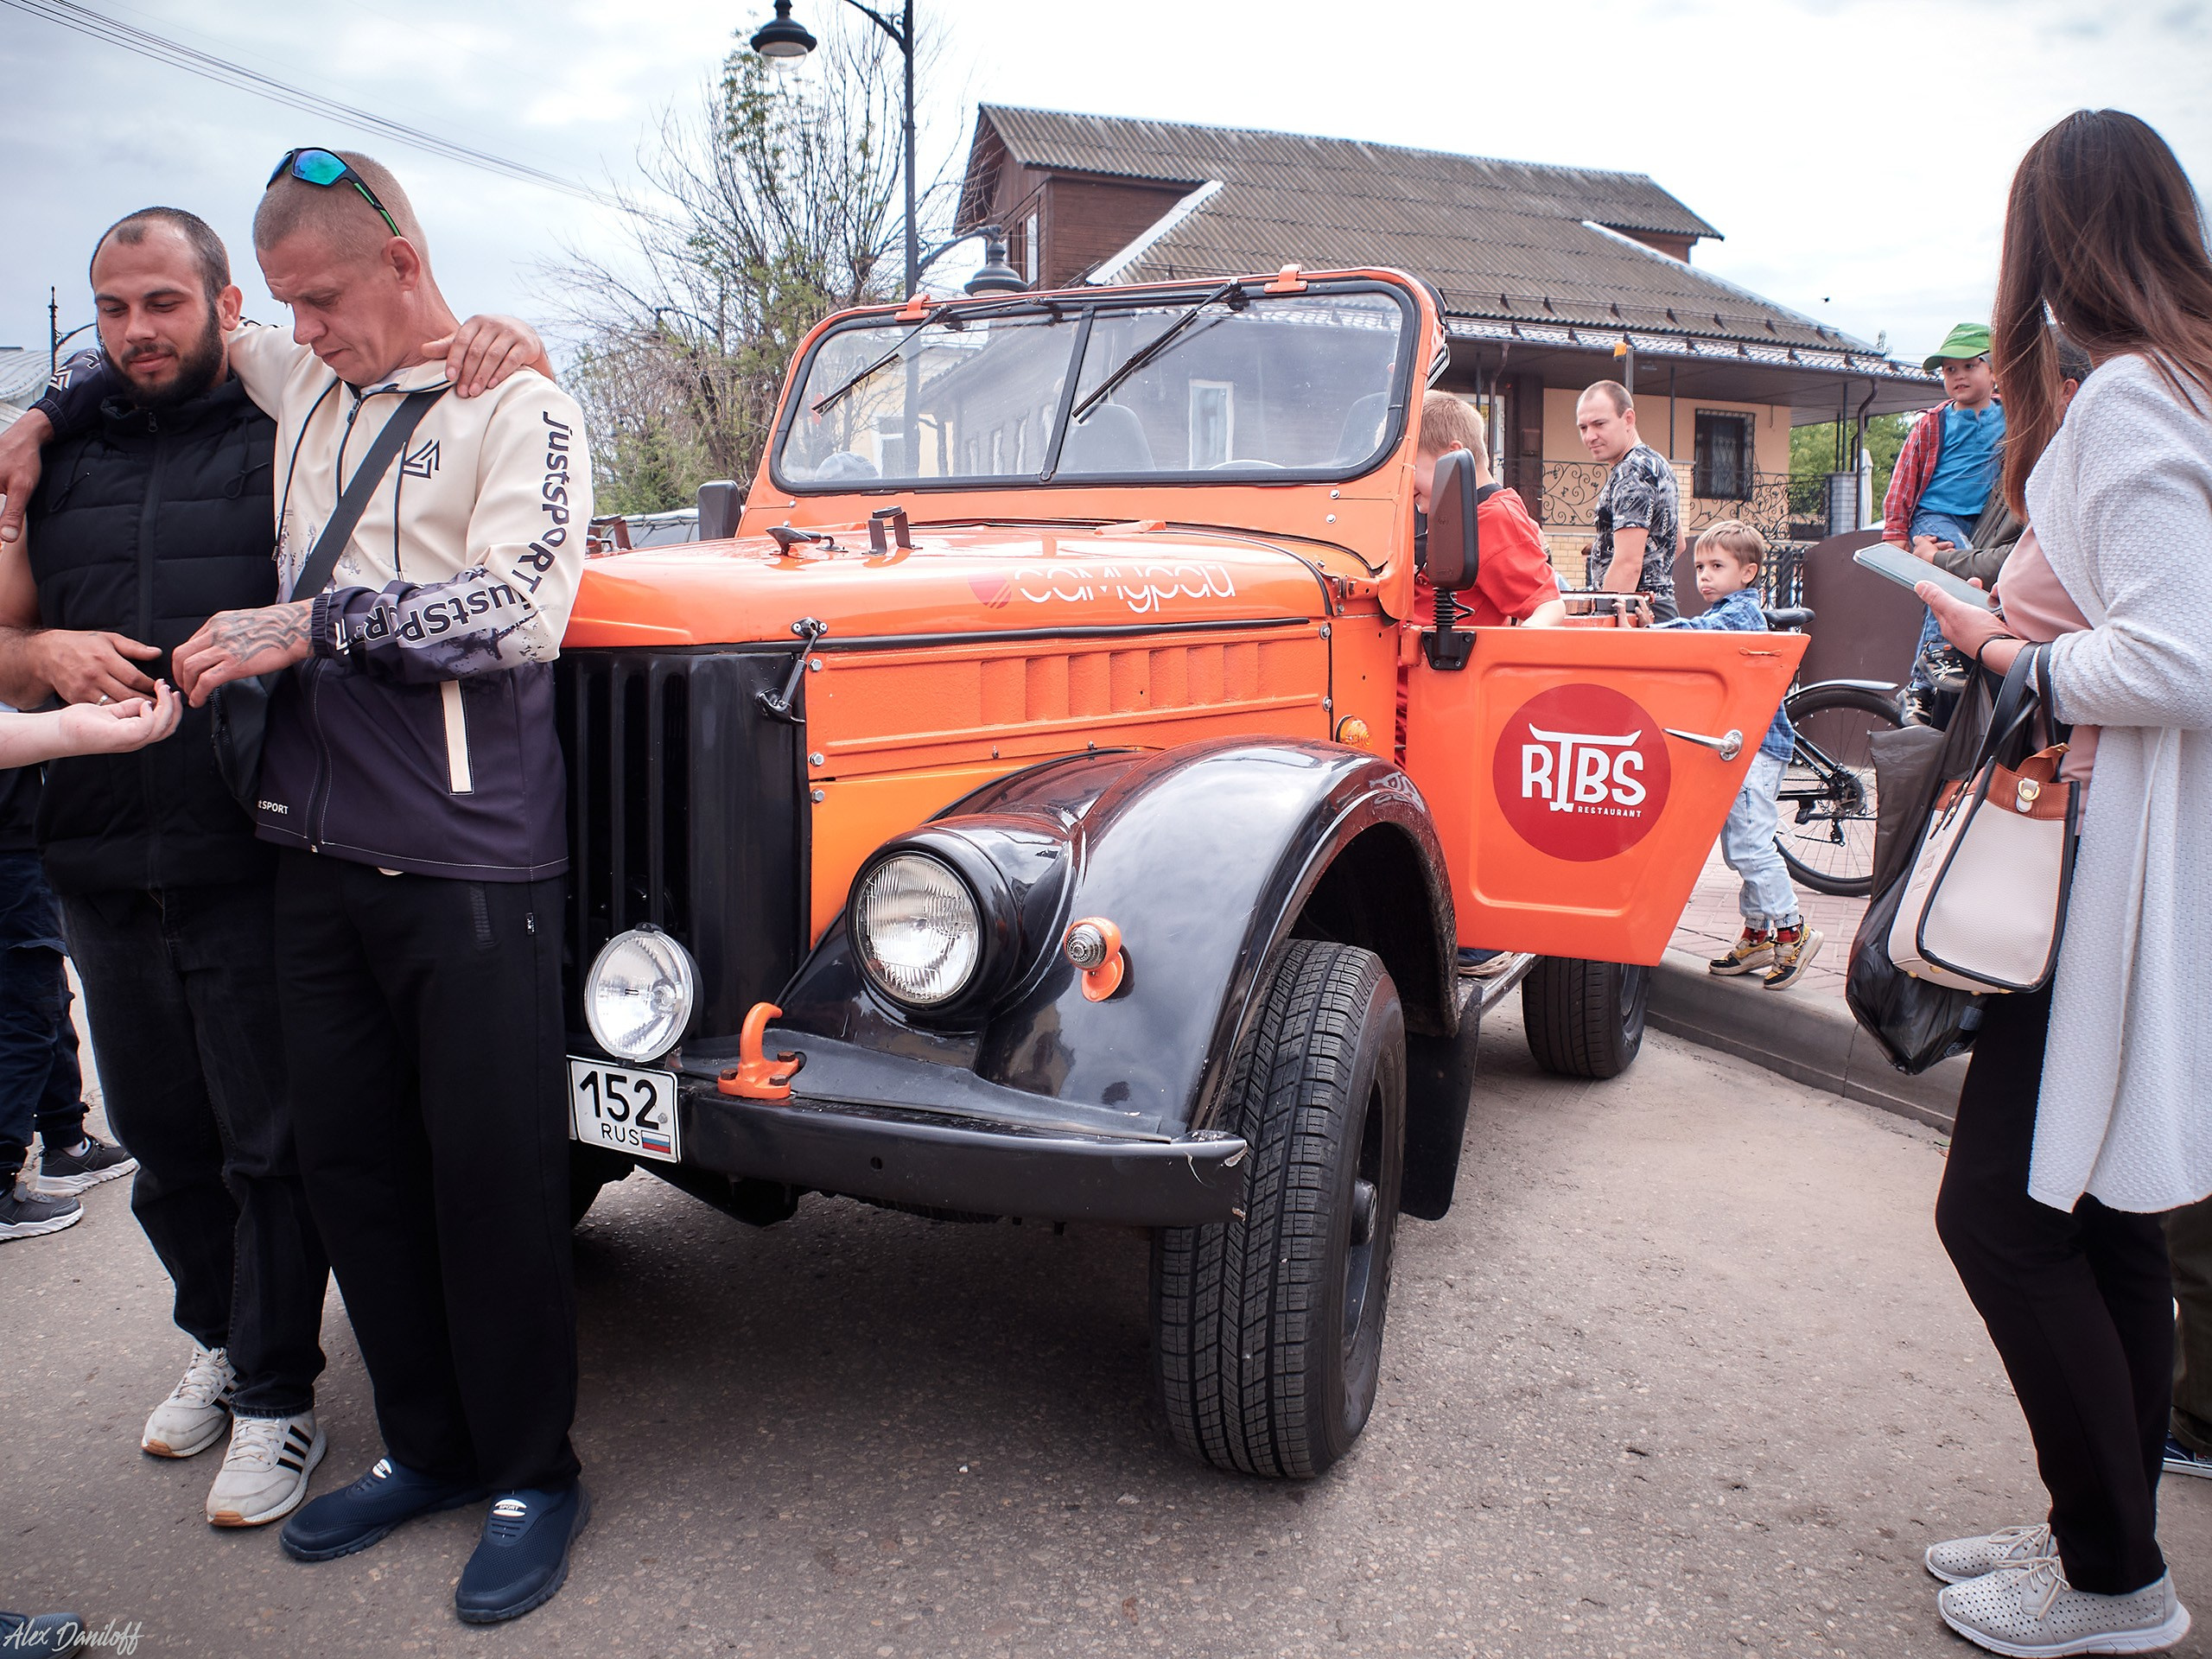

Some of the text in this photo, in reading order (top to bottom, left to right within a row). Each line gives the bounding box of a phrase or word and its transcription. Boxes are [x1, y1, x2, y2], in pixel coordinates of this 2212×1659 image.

[512, 411, 573, 594] justSPORT
[1578, 805, 1642, 818] RESTAURANT
[580, 1071, 659, 1130] 152
[601, 1122, 640, 1146] RUS
